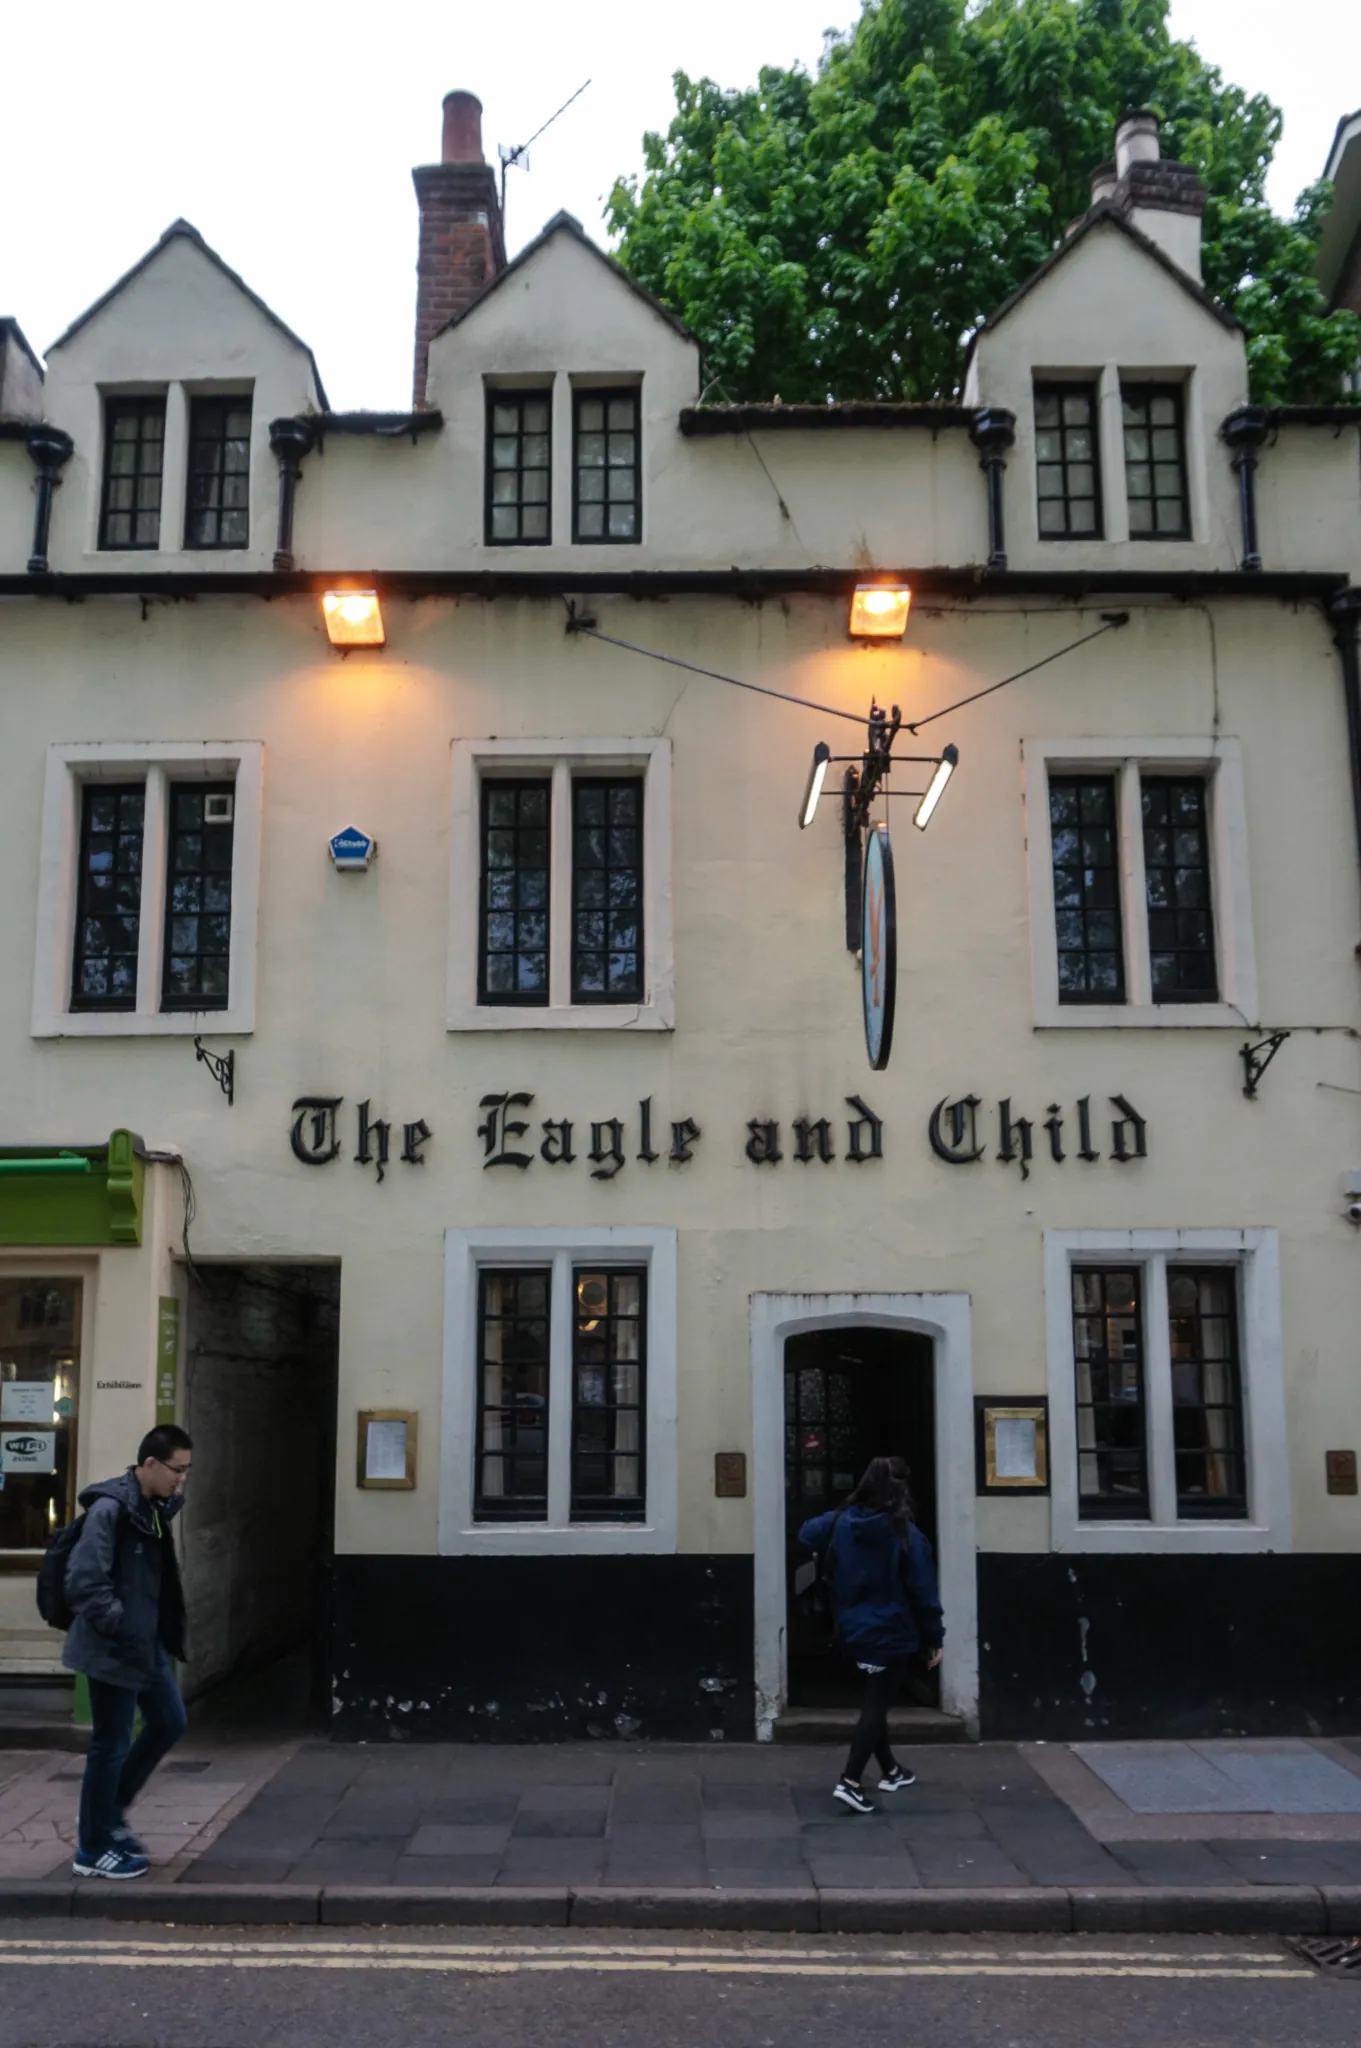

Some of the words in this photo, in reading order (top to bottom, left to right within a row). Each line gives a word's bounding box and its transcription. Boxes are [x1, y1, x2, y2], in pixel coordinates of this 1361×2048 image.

[290, 1096, 433, 1183] The
[477, 1091, 702, 1181] Eagle
[744, 1093, 884, 1166] and
[928, 1093, 1148, 1181] Child
